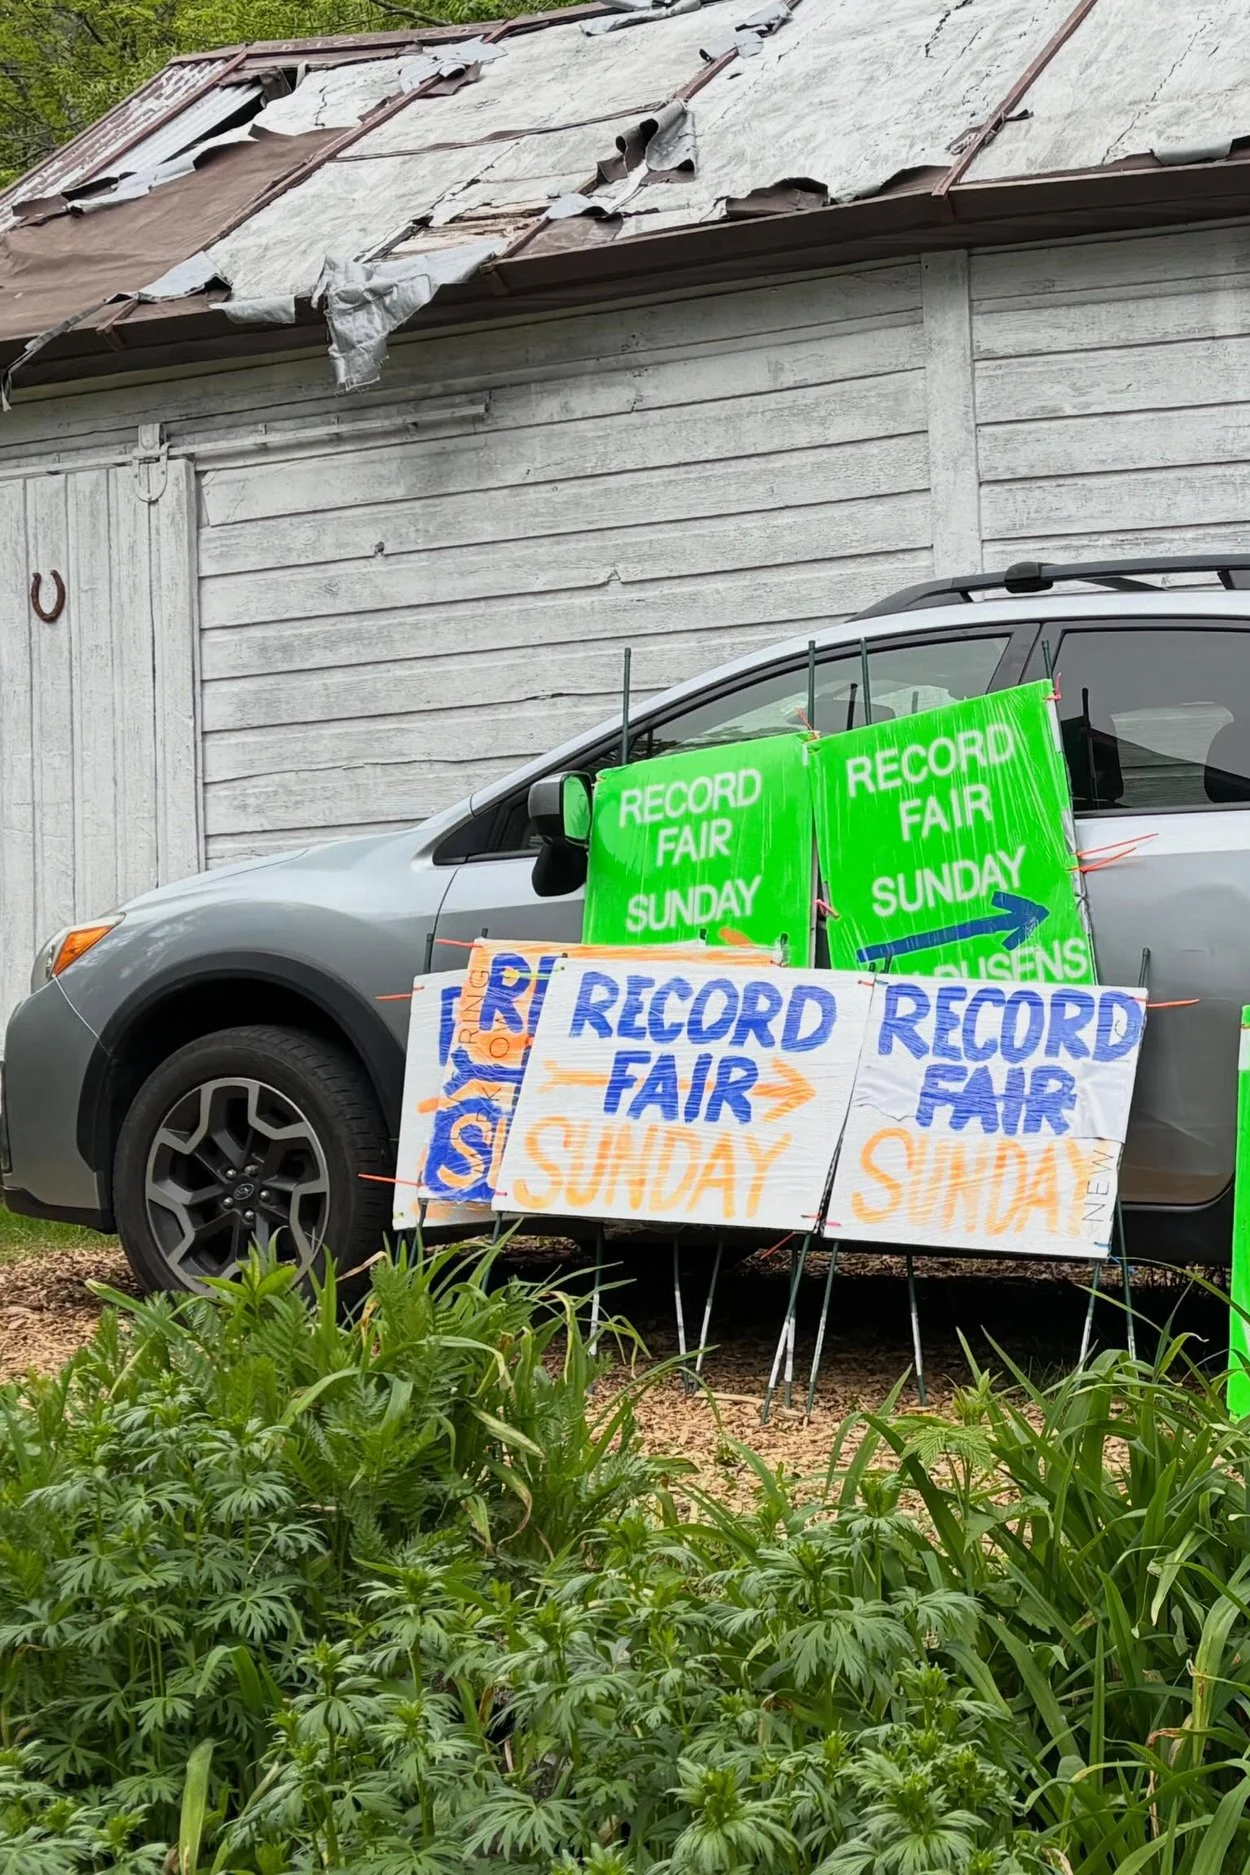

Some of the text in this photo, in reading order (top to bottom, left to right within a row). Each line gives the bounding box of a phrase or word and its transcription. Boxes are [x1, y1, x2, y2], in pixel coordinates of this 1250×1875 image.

[847, 722, 1015, 798] RECORD
[618, 768, 762, 829] RECORD
[899, 783, 994, 843] FAIR
[655, 818, 733, 867] FAIR
[626, 875, 762, 933] SUNDAY
[871, 845, 1026, 917] SUNDAY
[569, 971, 838, 1053] RECORD
[877, 982, 1144, 1063] RECORD
[602, 1049, 760, 1125] FAIR
[914, 1064, 1078, 1136] FAIR
[511, 1116, 793, 1220] SUNDAY
[850, 1126, 1111, 1236] SUNDAY
[1081, 1150, 1115, 1222] NEW
